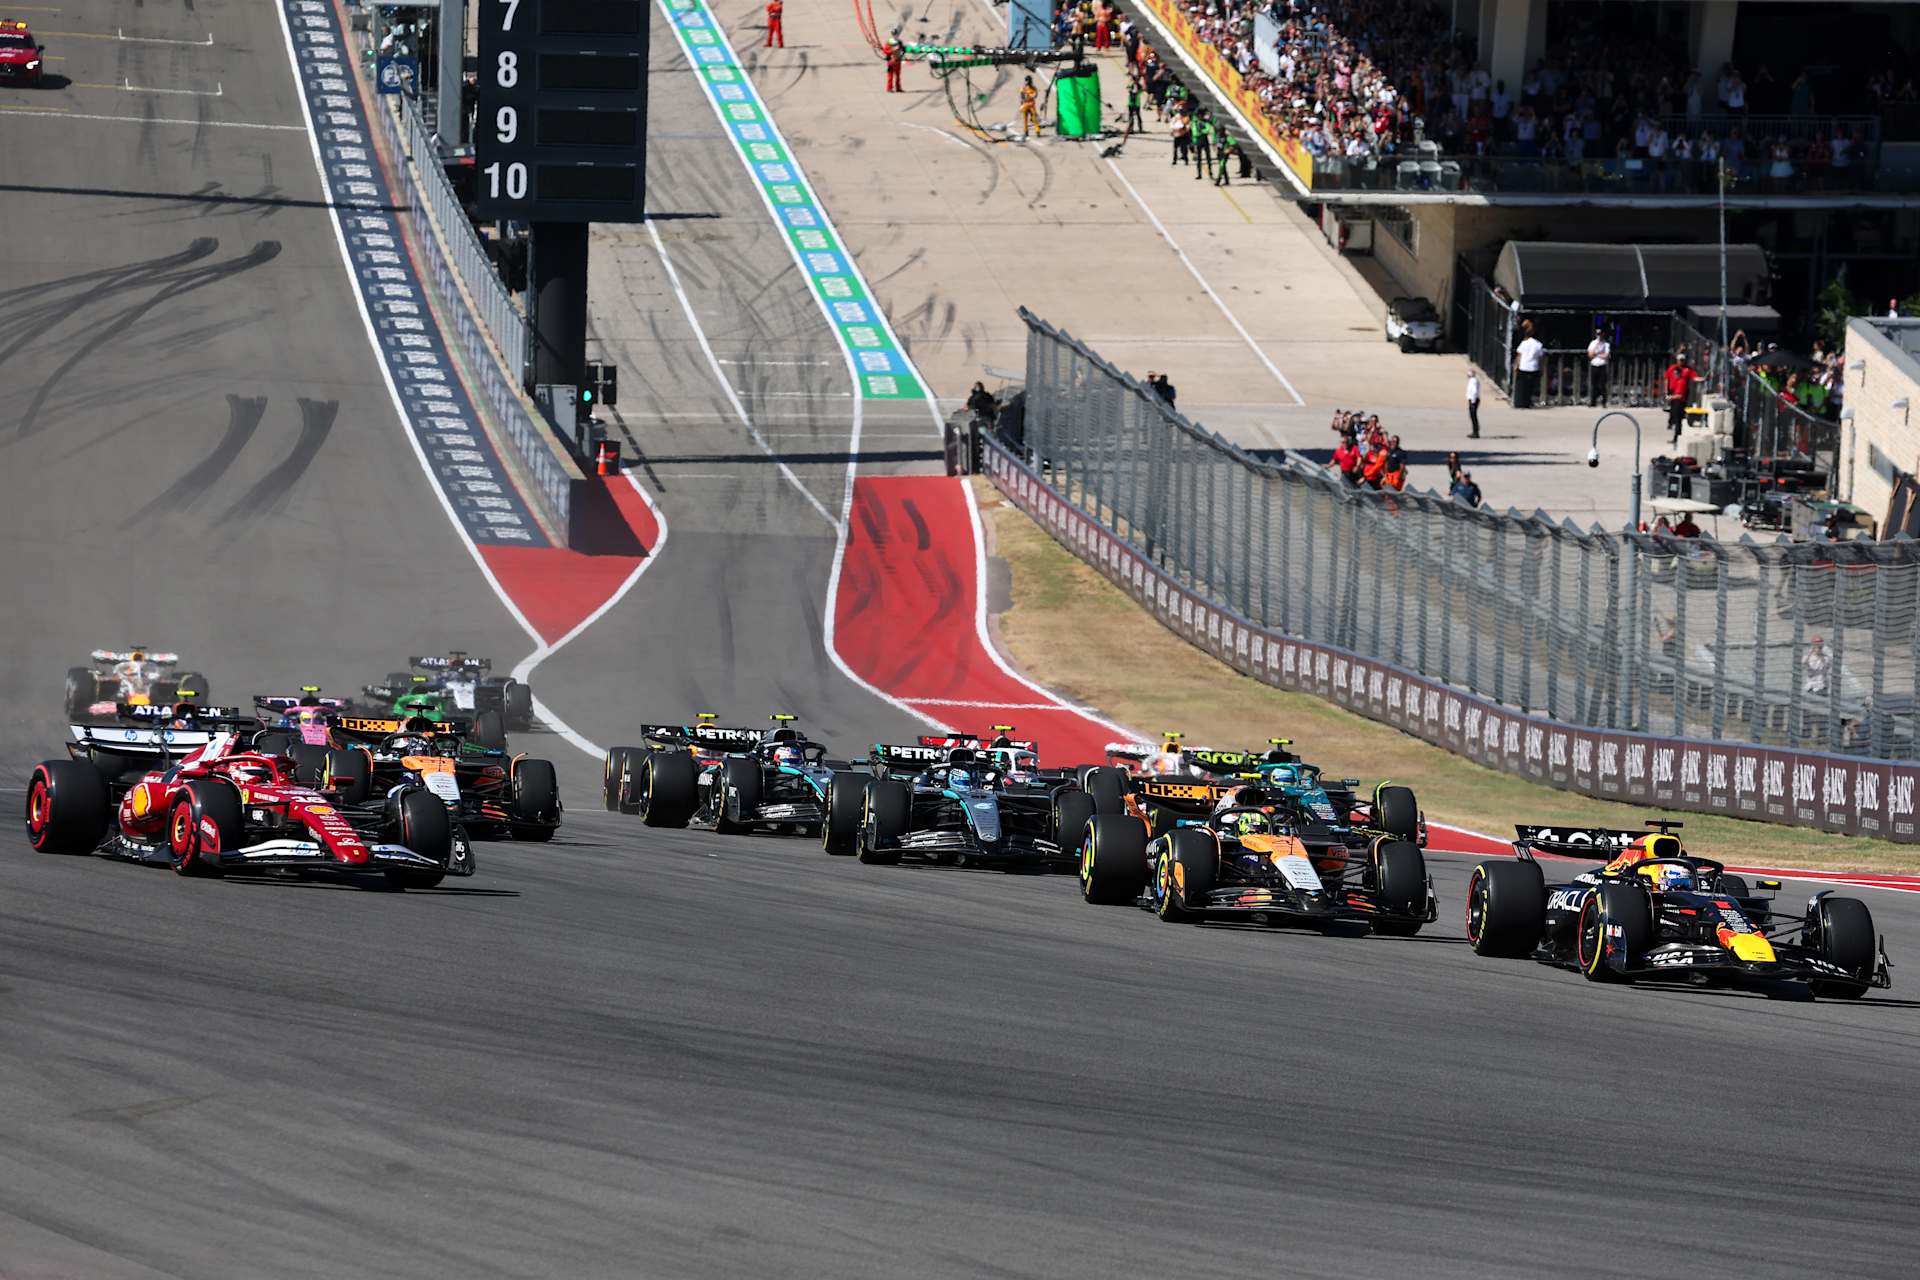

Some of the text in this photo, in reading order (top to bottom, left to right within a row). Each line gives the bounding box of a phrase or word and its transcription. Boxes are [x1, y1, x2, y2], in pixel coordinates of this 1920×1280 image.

[499, 0, 520, 31] 7
[497, 50, 519, 88] 8
[496, 106, 518, 143] 9
[484, 162, 528, 199] 10
[420, 657, 479, 667] ATLAAN
[695, 728, 762, 741] PETRON
[890, 746, 987, 760] PETROS
[1799, 764, 1816, 801] MSC
[1830, 767, 1847, 806] MSC
[1862, 771, 1880, 811] MSC
[1896, 775, 1915, 815] MSC
[1547, 890, 1589, 912] ORACL
